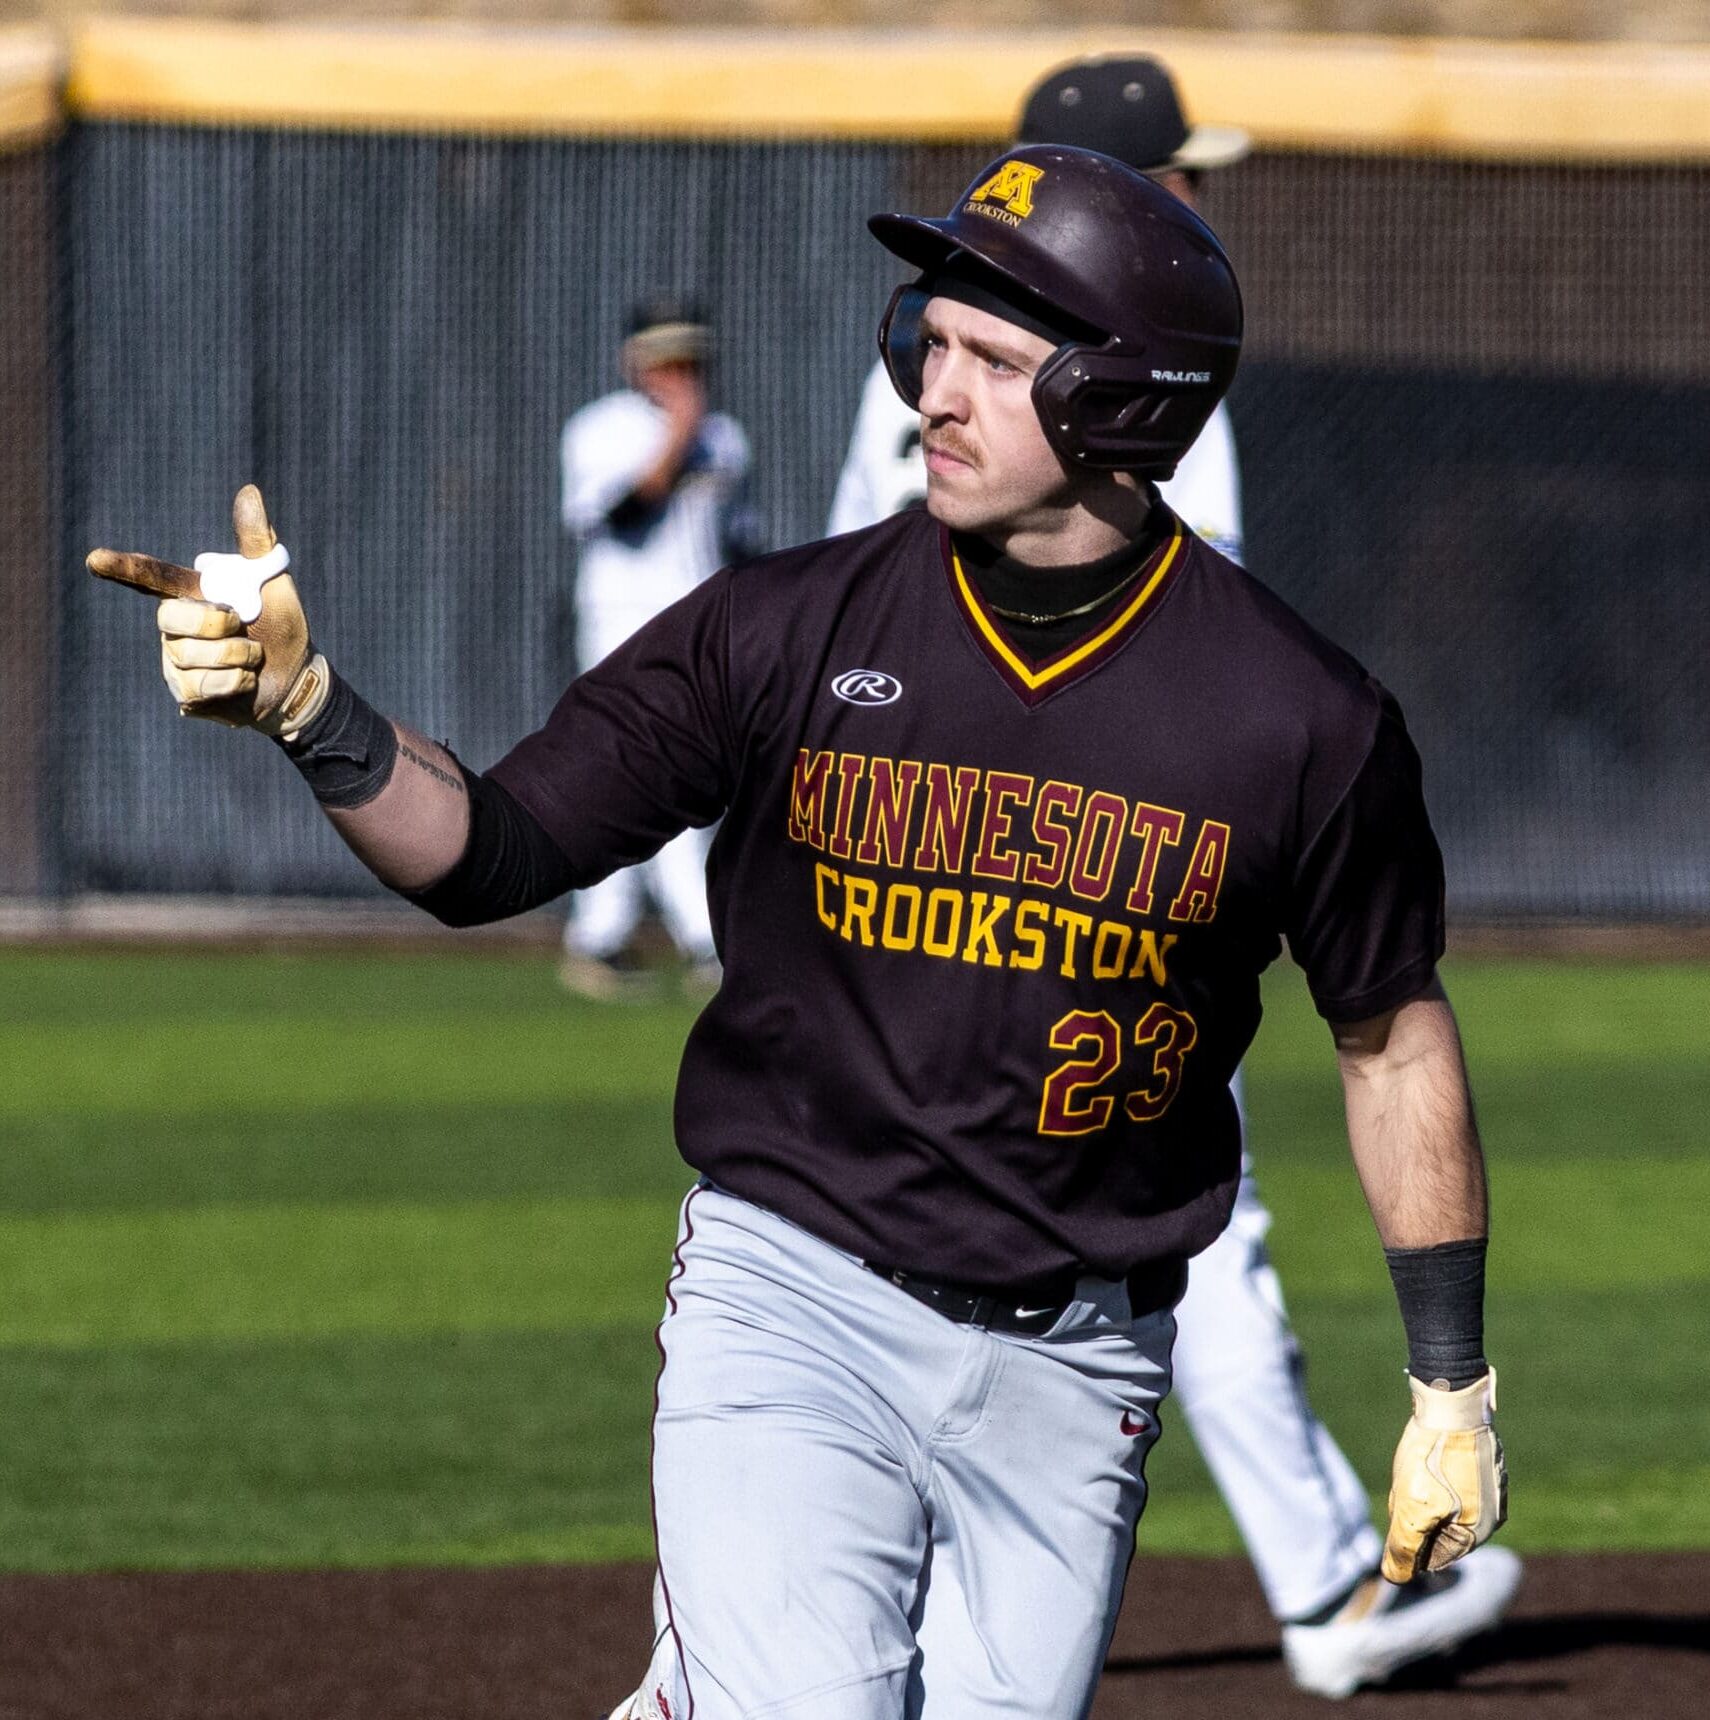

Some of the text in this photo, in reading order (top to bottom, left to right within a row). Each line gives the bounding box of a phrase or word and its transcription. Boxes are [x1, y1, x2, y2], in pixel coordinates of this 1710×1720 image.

[963, 201, 1022, 228] CROOKSTON
[788, 748, 1231, 923] MINNESOTA
[815, 862, 1178, 987] CROOKSTON
[1037, 1001, 1198, 1136] 23
